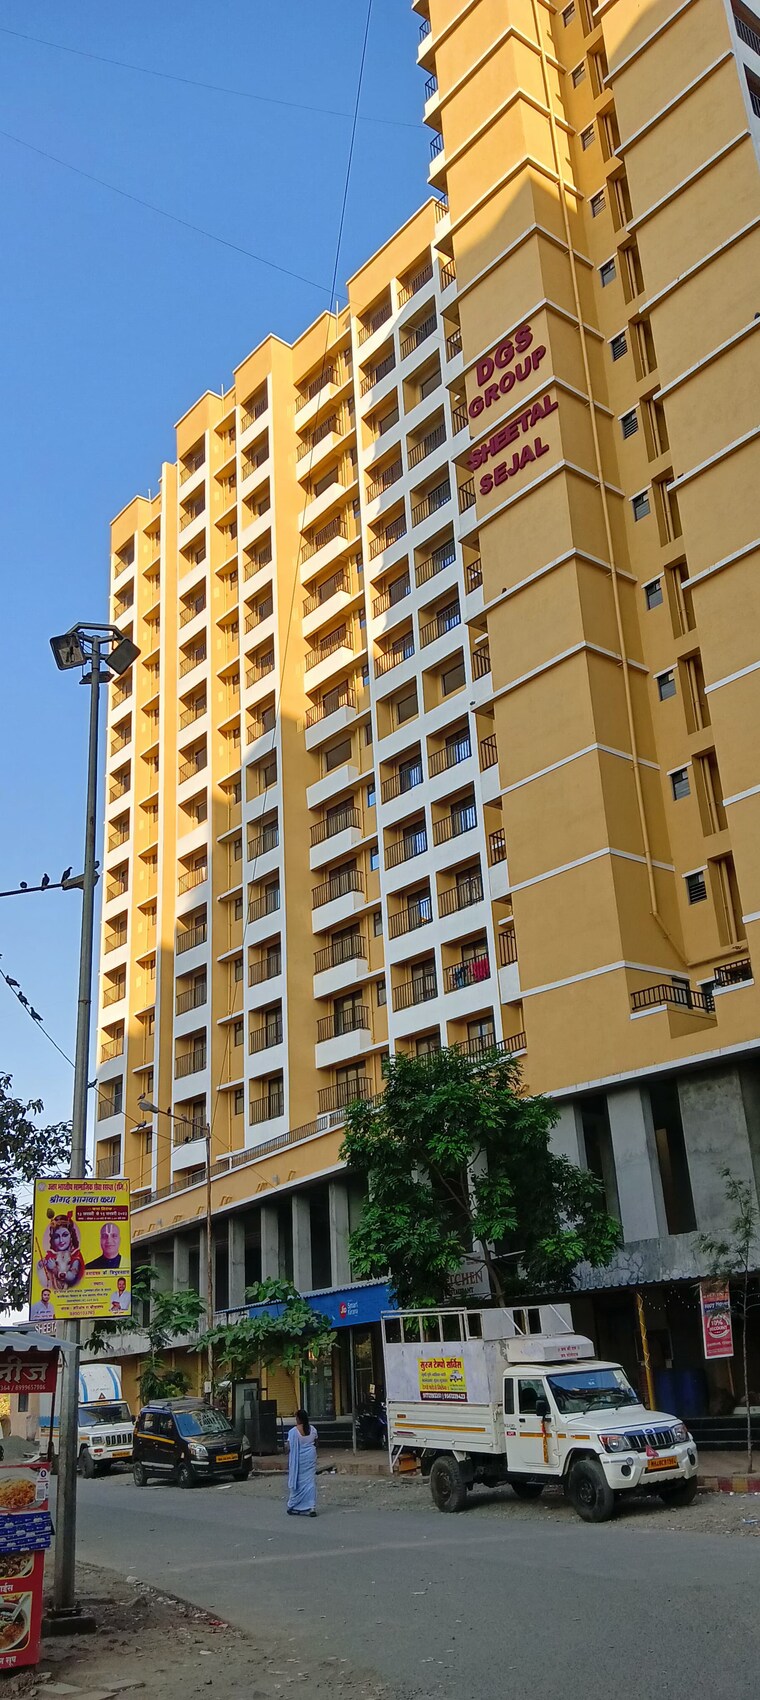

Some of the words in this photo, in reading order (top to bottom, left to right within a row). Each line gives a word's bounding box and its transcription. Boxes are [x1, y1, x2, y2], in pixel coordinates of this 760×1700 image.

[468, 345, 547, 418] GROUP
[476, 325, 533, 387] DGS
[466, 394, 559, 471] SHEETAL
[479, 437, 549, 496] SEJAL
[72, 1196, 99, 1204] भागवत
[100, 1196, 116, 1204] कथा
[448, 1271, 483, 1286] TCHEN
